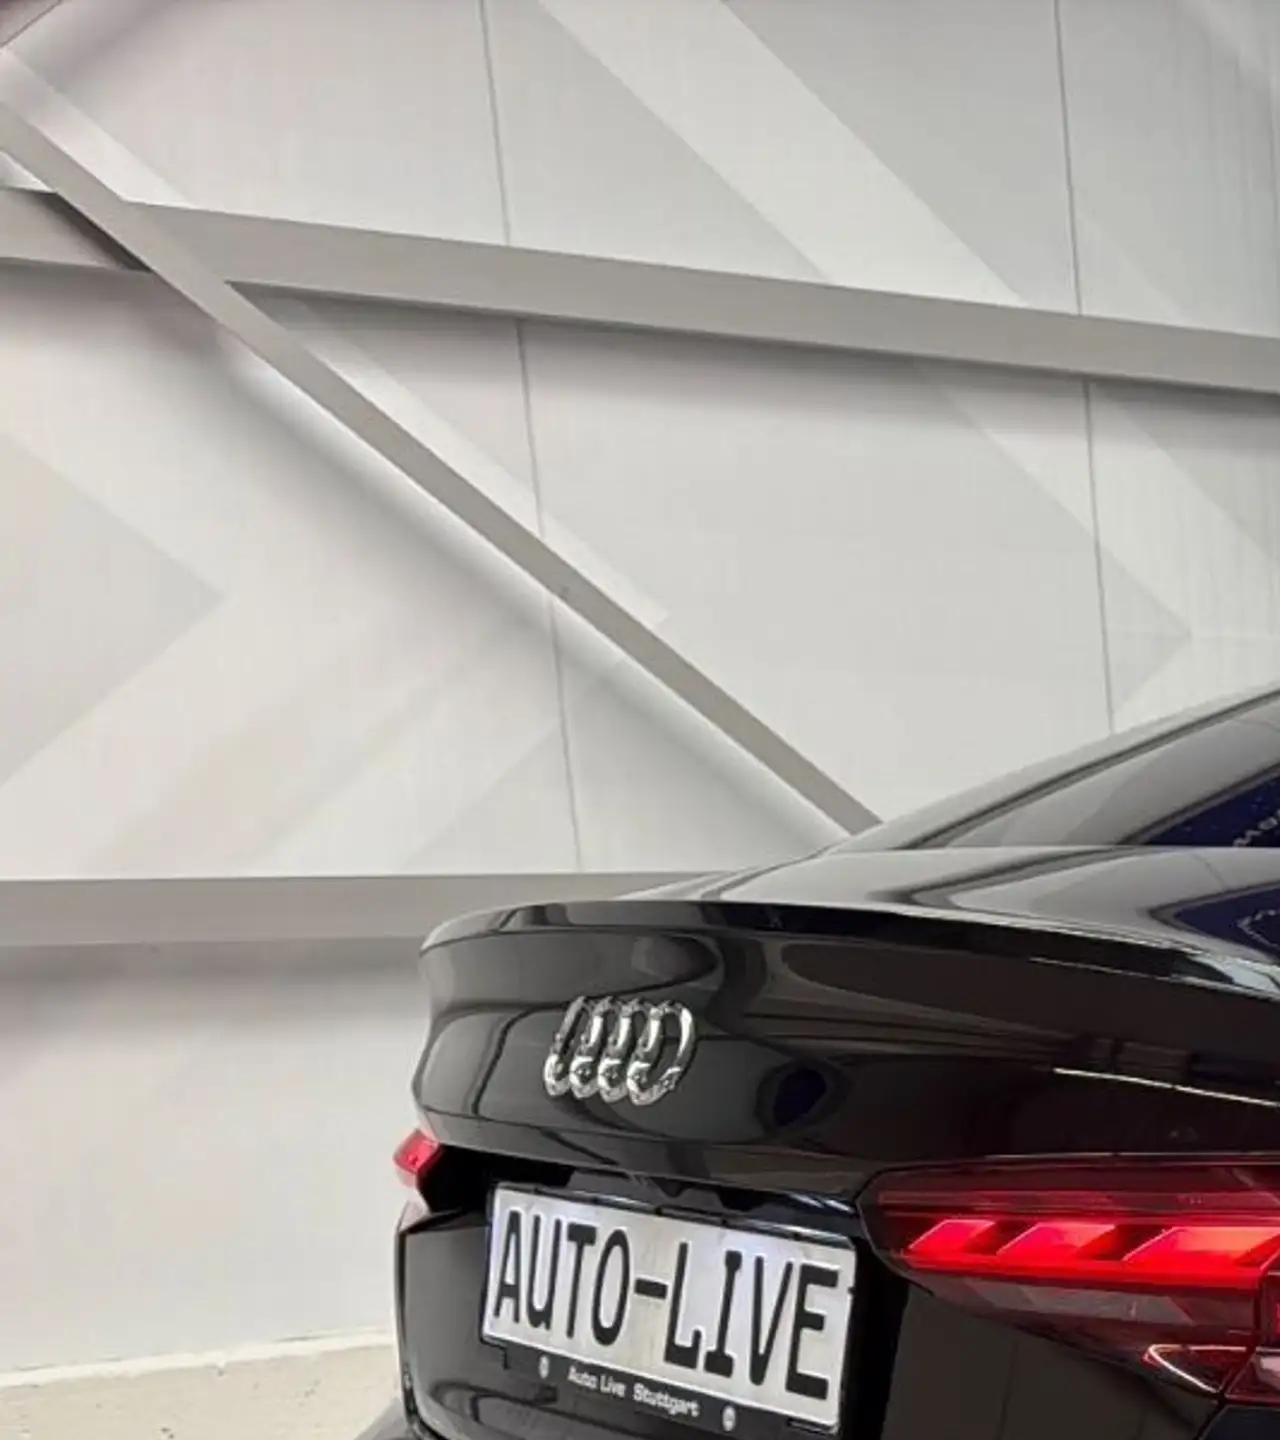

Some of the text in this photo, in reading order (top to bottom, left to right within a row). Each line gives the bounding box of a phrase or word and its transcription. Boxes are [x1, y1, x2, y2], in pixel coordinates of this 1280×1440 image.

[493, 1208, 839, 1400] AUTO-LIVE
[567, 1365, 701, 1418] Auto Live Stuttgart
